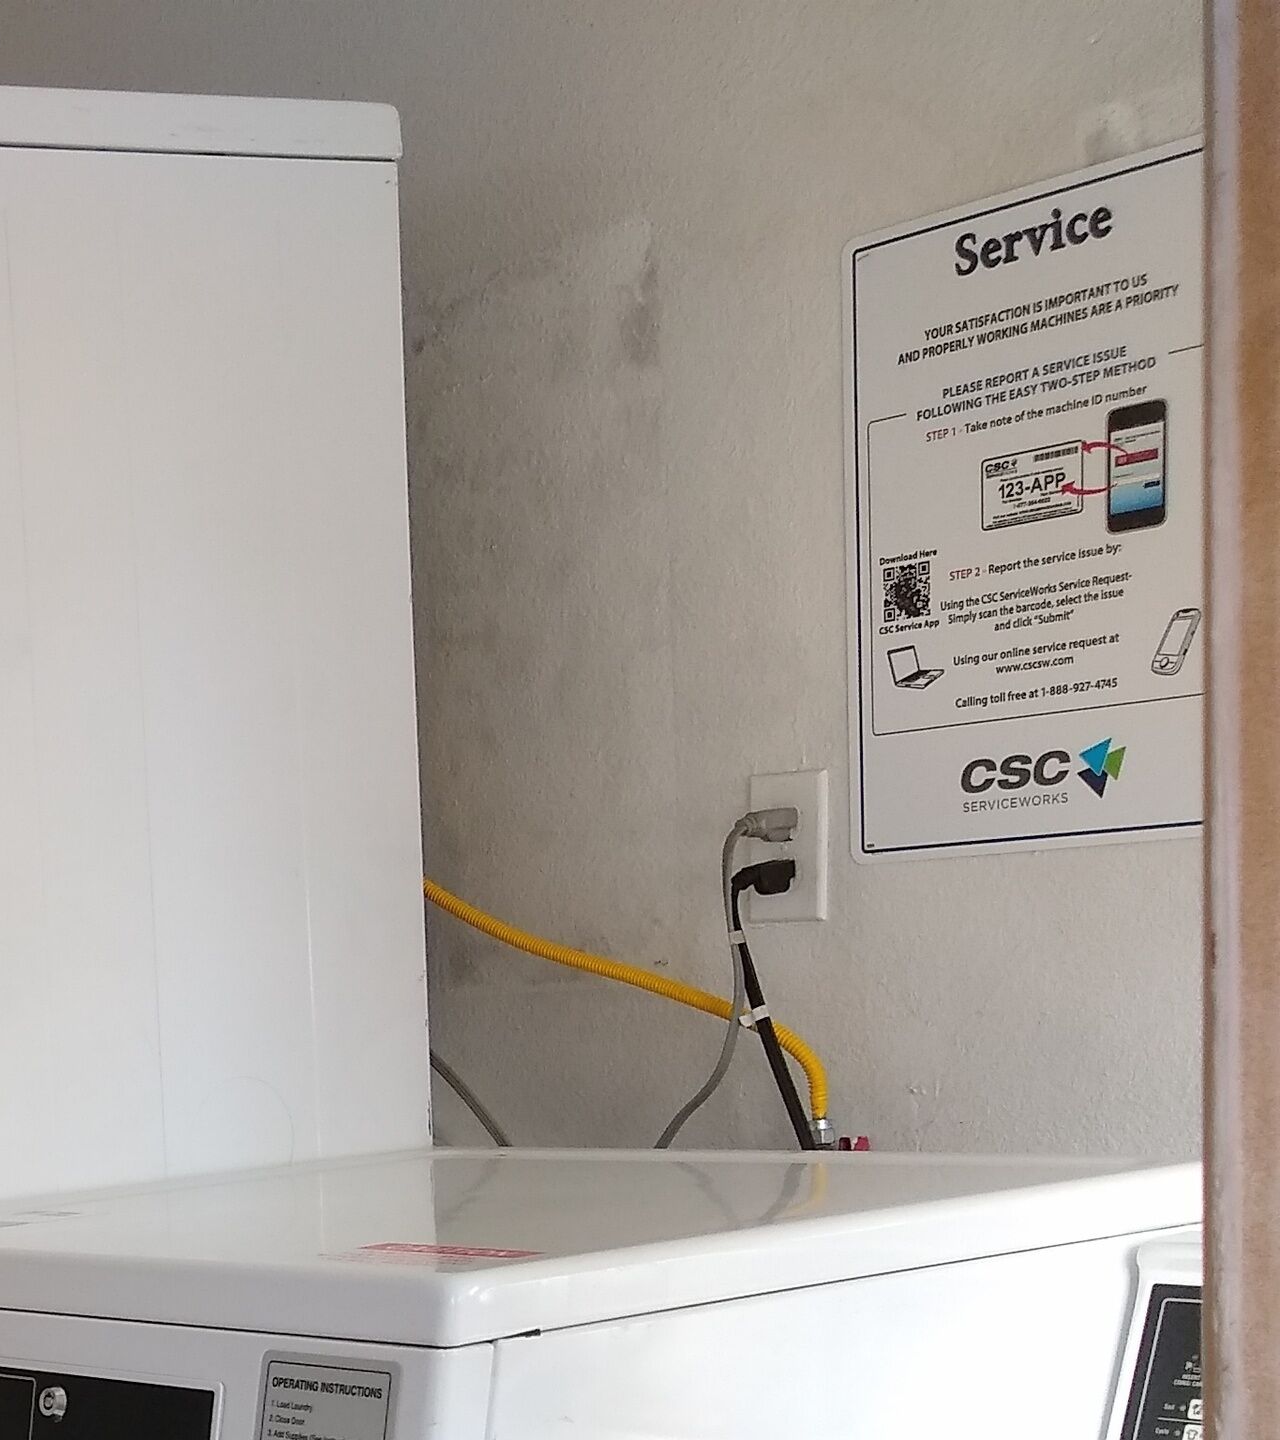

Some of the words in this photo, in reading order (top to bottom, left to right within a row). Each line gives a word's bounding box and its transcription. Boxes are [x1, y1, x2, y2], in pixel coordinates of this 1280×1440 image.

[954, 206, 1113, 277] Service
[897, 350, 920, 366] AND
[922, 336, 975, 361] PROPERLY
[977, 320, 1029, 347] WORKING
[1030, 307, 1088, 333] MACHINES
[1091, 302, 1113, 318] ARE
[1114, 301, 1123, 313] A
[1125, 283, 1179, 308] PRIORITY
[924, 325, 954, 341] YOUR
[955, 303, 1031, 334] SATISFACTION
[1032, 301, 1044, 314] IS
[1045, 282, 1112, 313] IMPORTANT
[1114, 279, 1129, 292] TO
[1131, 273, 1148, 288] US
[916, 397, 983, 422] FOLLOWING
[985, 392, 1007, 406] THE
[1009, 386, 1038, 401] EASY
[1040, 370, 1101, 394] TWO-STEP
[1103, 356, 1157, 379] METHOD
[942, 382, 983, 399] PLEASE
[985, 370, 1029, 389] REPORT
[1031, 368, 1040, 379] A
[1042, 354, 1091, 376] SERVICE
[1092, 345, 1128, 363] ISSUE
[925, 428, 949, 443] STEP
[950, 427, 956, 437] 1
[964, 421, 988, 435] Take
[990, 416, 1012, 428] note
[1014, 410, 1025, 422] of
[1026, 408, 1044, 421] the
[1045, 397, 1090, 416] machine
[1091, 394, 1102, 406] ID
[1105, 385, 1148, 403] number
[997, 471, 1066, 499] 123-APP
[953, 653, 980, 667] Using
[981, 652, 998, 661] our
[1000, 645, 1031, 659] online
[1033, 642, 1067, 656] service
[1069, 636, 1108, 653] request
[1109, 633, 1119, 644] at
[995, 654, 1074, 674] www.cscsw.com
[955, 694, 988, 710] Calling
[990, 692, 1006, 704] toll
[1007, 689, 1027, 702] free
[1028, 688, 1040, 699] at
[1041, 677, 1118, 697] 1-888-927-4745
[960, 749, 1071, 794] CSC
[963, 792, 1069, 813] SERVICEWORKS
[271, 1376, 319, 1392] OPERATING
[320, 1381, 383, 1400] INSTRUCTIONS
